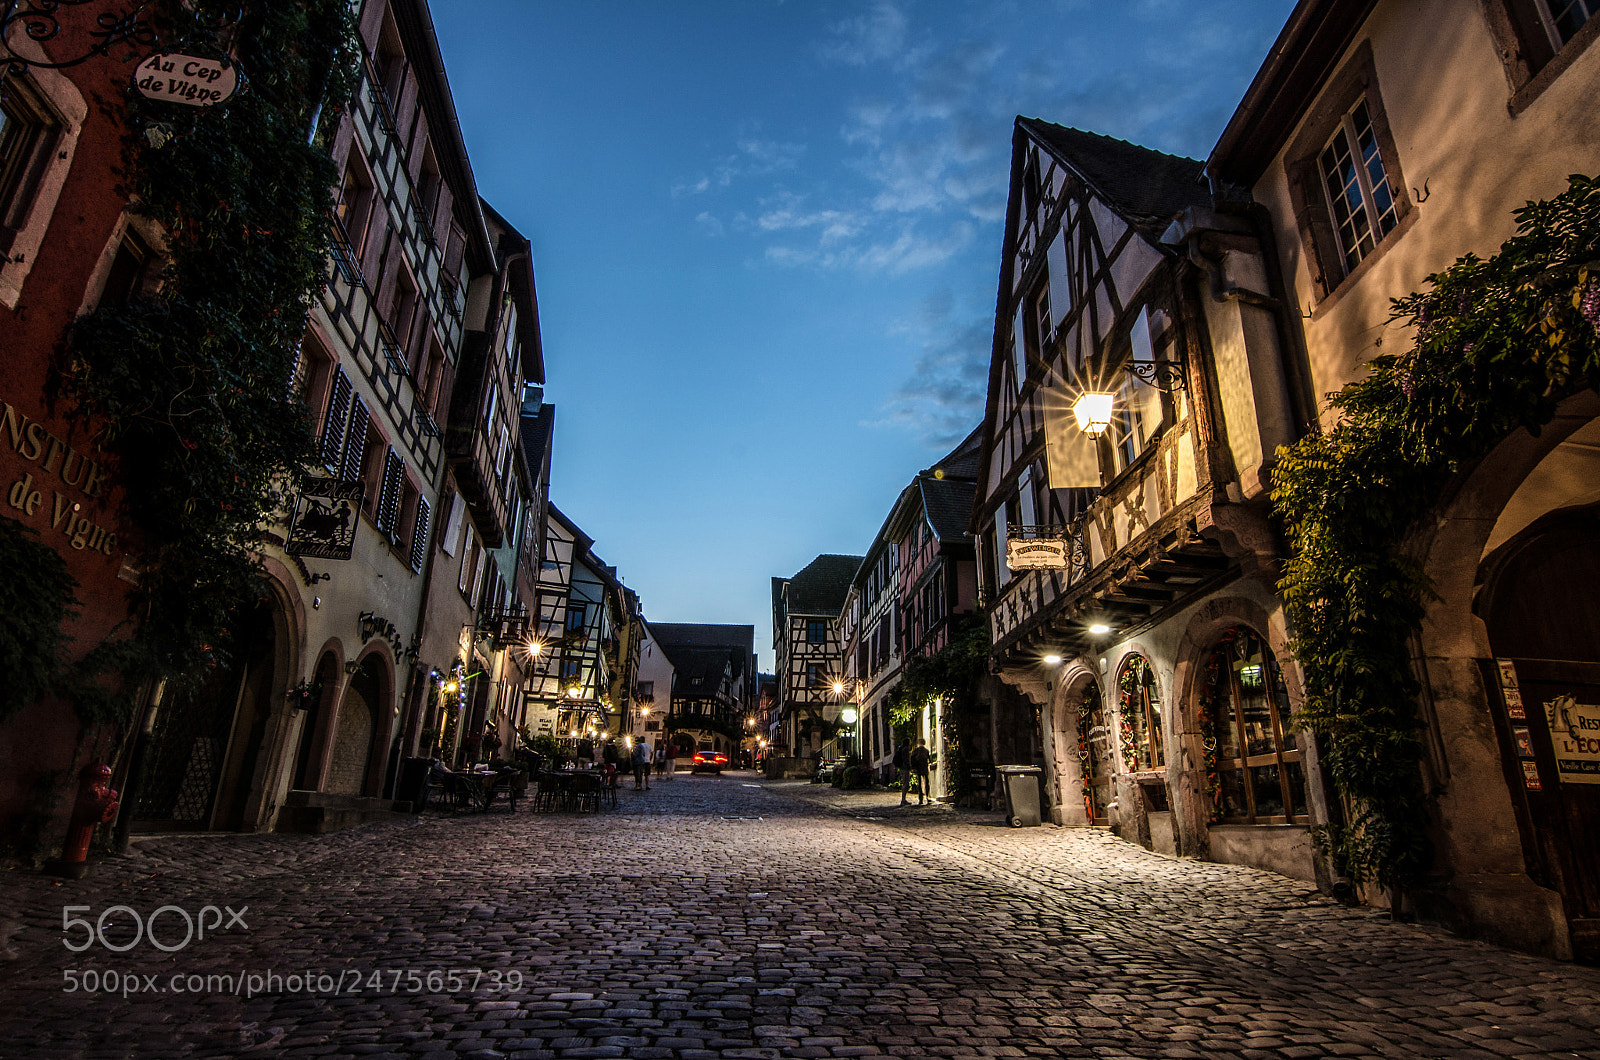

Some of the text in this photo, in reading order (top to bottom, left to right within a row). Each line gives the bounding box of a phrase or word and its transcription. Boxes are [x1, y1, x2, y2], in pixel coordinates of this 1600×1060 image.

[145, 56, 222, 83] Au Cep
[139, 76, 222, 102] de Vigne
[8, 472, 118, 556] de Vigne
